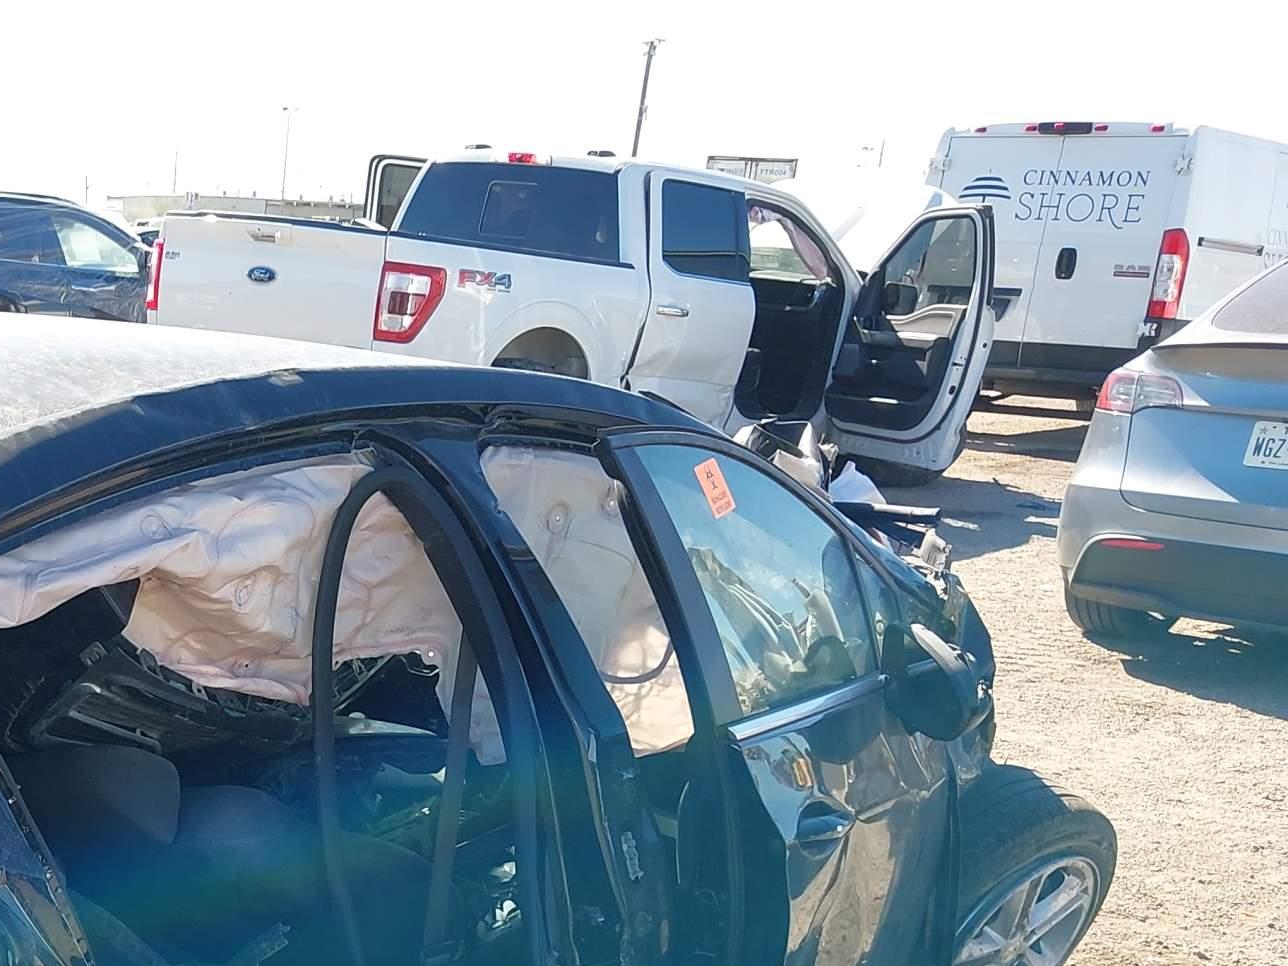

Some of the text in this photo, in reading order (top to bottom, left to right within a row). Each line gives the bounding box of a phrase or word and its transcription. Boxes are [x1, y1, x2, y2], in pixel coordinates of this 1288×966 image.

[1023, 169, 1152, 187] CINNAMON
[1014, 191, 1145, 229] SHORE
[1113, 264, 1151, 272] RAM
[458, 268, 512, 289] FX4
